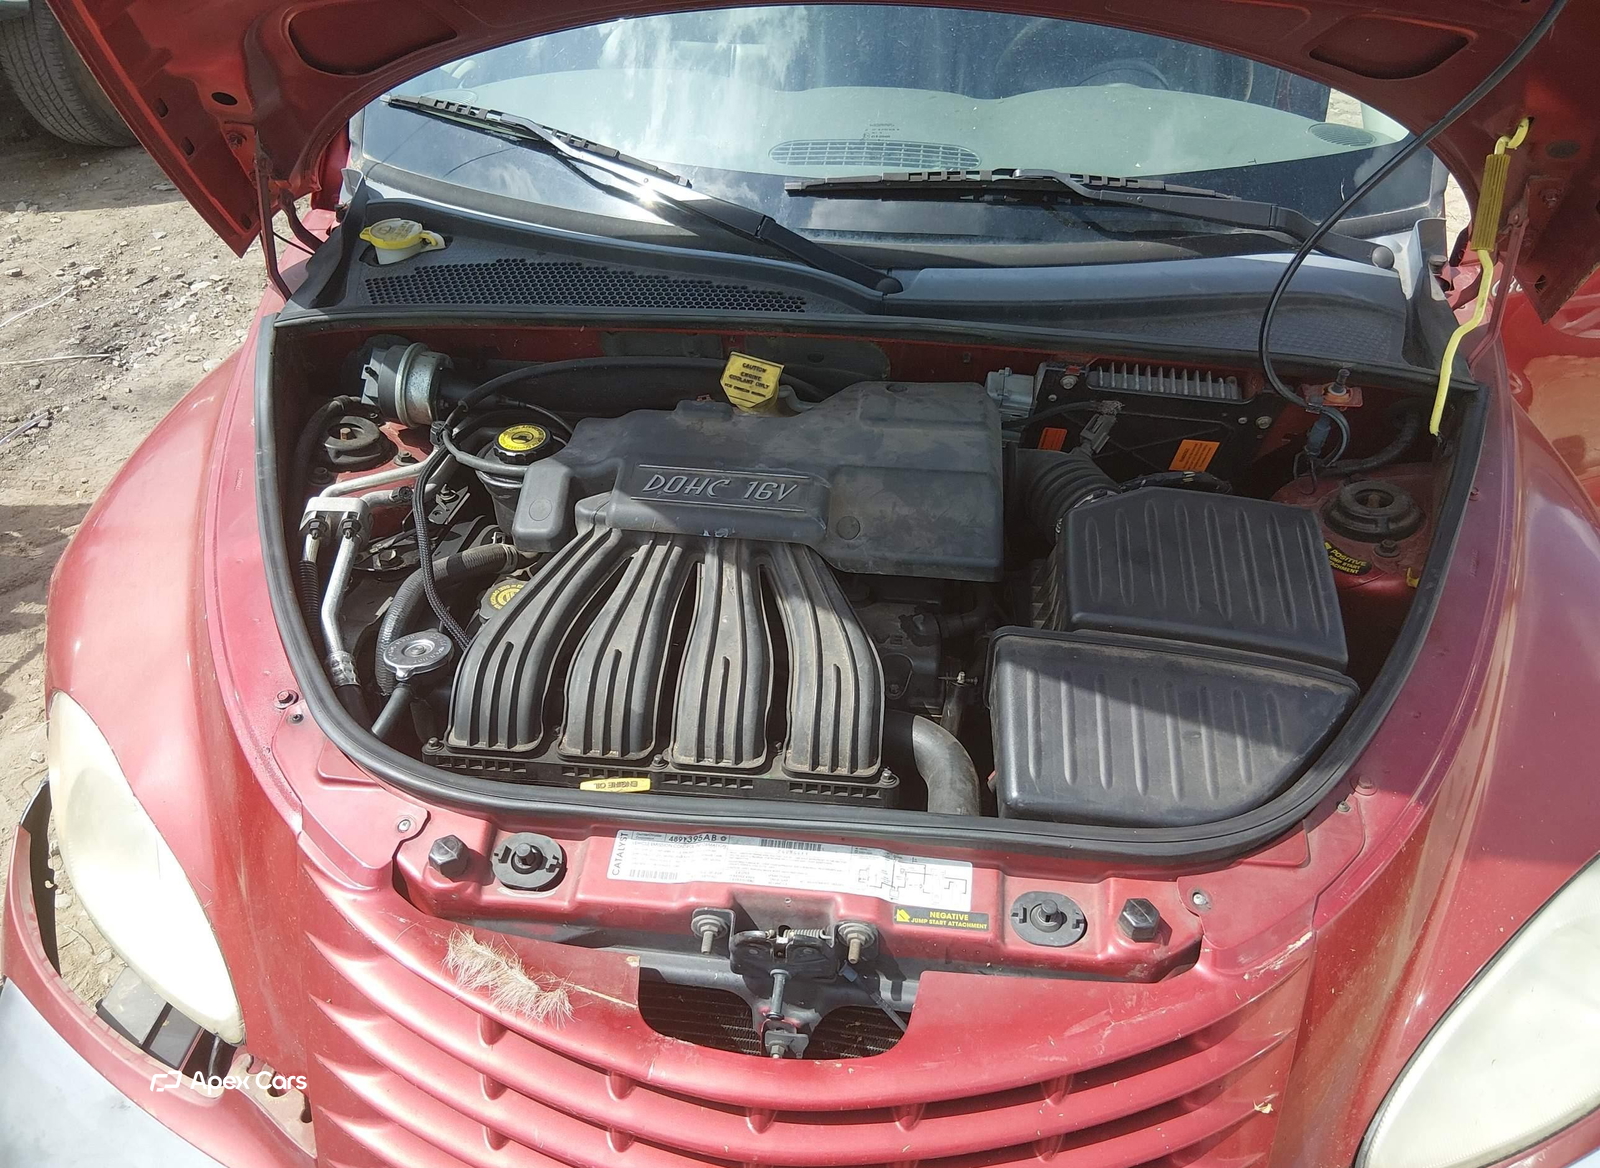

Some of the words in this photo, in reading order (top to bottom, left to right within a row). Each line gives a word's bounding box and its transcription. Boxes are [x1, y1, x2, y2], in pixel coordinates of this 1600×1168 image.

[742, 362, 766, 373] CAUTION
[729, 374, 753, 384] COOLANT
[643, 474, 731, 498] DOHC
[743, 481, 798, 502] 16V
[1330, 549, 1367, 567] POSITIVE
[1342, 562, 1361, 570] START
[611, 832, 629, 876] CATALYST
[929, 911, 969, 921] NEGATIVE
[947, 921, 988, 930] ATTACHMENT
